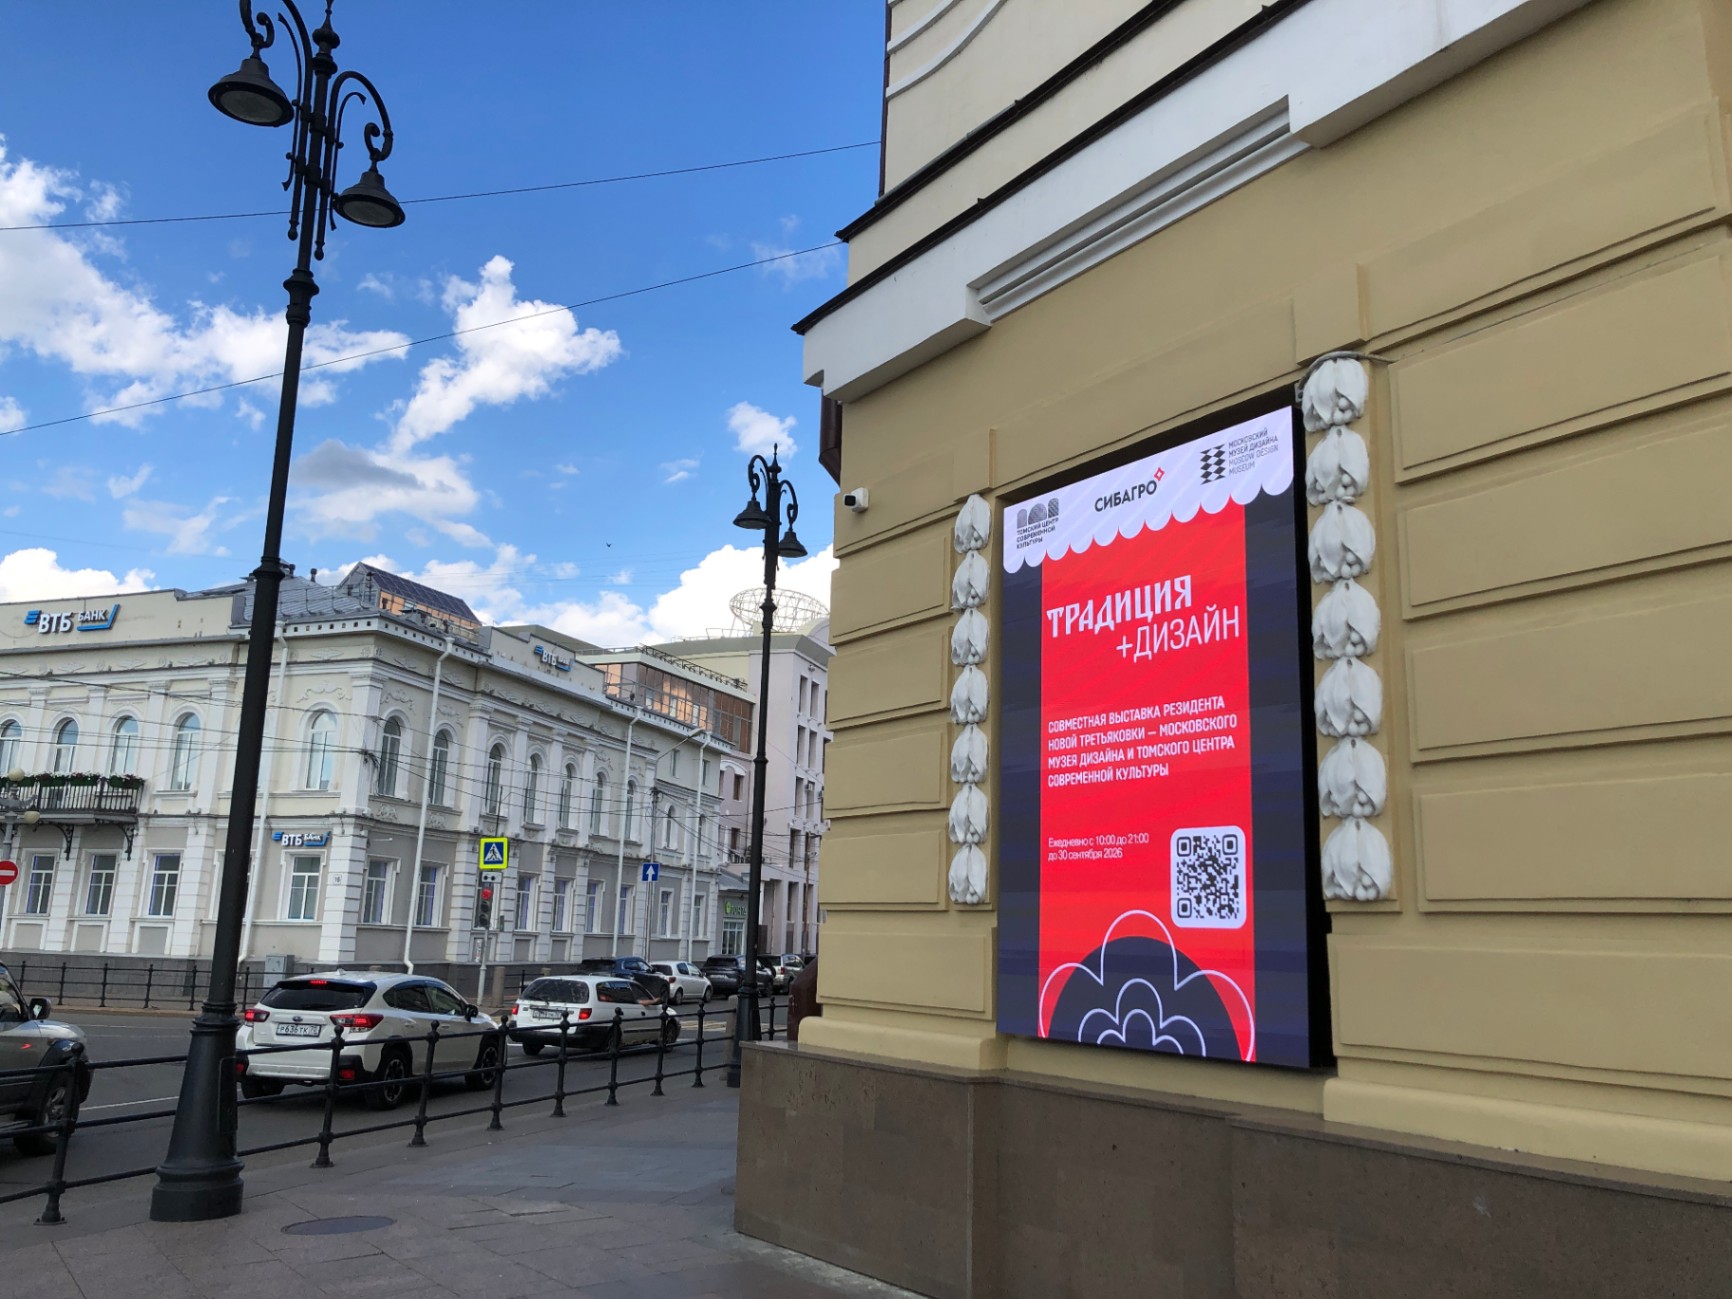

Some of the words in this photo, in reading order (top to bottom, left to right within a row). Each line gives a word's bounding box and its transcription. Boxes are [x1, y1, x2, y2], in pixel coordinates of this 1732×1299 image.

[1229, 427, 1268, 448] МОСКОВСКИЙ
[1229, 444, 1248, 458] МУЗЕЙ
[1249, 435, 1278, 452] ДИЗАЙНА
[1229, 451, 1254, 467] MOSCOW
[1229, 461, 1255, 476] MUSEUM
[1094, 479, 1157, 513] СИБАГРО
[1046, 574, 1192, 638] ТРАДИЦИЯ
[38, 612, 72, 634] ВТБ
[77, 609, 107, 622] БАНК
[1116, 604, 1240, 663] +ДИЗАЙН
[542, 650, 557, 666] ВТБ
[1048, 713, 1107, 734] СОВМЕСТНАЯ
[1109, 704, 1160, 725] ВЫСТАВКА
[1163, 695, 1225, 717] РЕЗИДЕНТА
[1048, 732, 1077, 752] НОВОЙ
[1079, 726, 1145, 746] ТРЕТЬЯКОВКИ
[1159, 713, 1238, 737] МОСКОВСКОГО
[1048, 753, 1077, 769] МУЗЕЯ
[1079, 746, 1125, 768] ДИЗАЙНА
[1127, 746, 1134, 760] И
[1137, 740, 1190, 759] ТОМСКОГО
[1192, 734, 1235, 755] ЦЕНТРА
[1048, 767, 1113, 788] СОВРЕМЕННОЙ
[1115, 762, 1169, 782] КУЛЬТУРЫ
[281, 834, 302, 847] ВТБ
[1048, 836, 1088, 849] Ежедневно
[1095, 834, 1116, 846] 10:00
[1116, 836, 1127, 847] до
[1127, 833, 1149, 844] 21:00
[1048, 850, 1058, 861] до
[1058, 849, 1067, 860] 30
[1068, 849, 1103, 861] сентября
[1103, 847, 1123, 859] 2026
